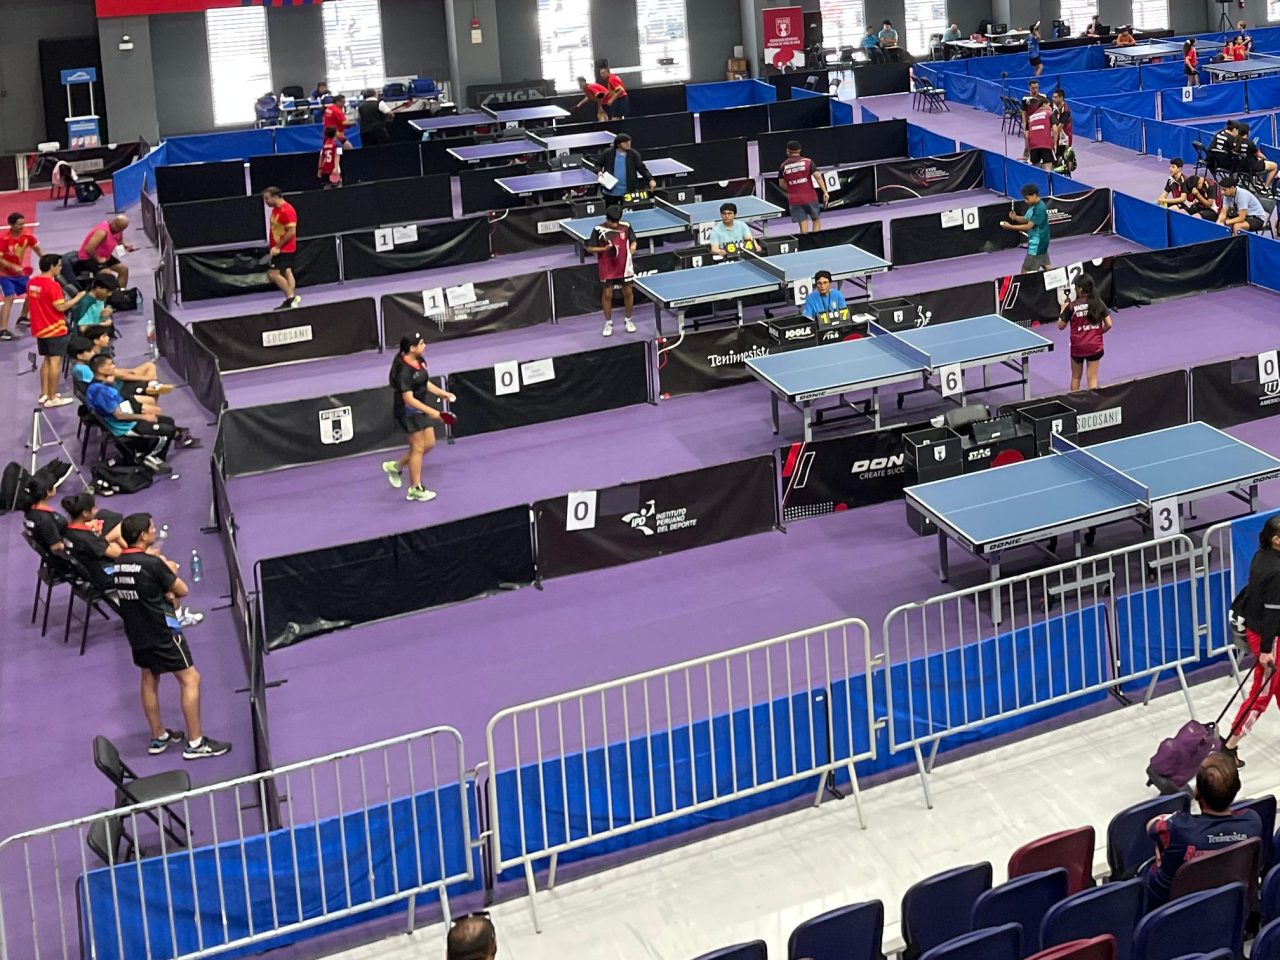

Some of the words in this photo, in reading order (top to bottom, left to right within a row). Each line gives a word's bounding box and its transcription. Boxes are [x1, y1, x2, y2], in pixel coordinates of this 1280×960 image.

[829, 176, 836, 187] 0
[967, 213, 975, 224] 0
[380, 234, 388, 246] 1
[798, 285, 809, 300] 9
[429, 295, 440, 309] 1
[840, 308, 849, 320] 7
[266, 327, 310, 344] SOCOSANI
[785, 326, 812, 339] JOOLA
[1021, 348, 1046, 356] DONIC
[1264, 359, 1274, 376] 0
[501, 371, 513, 386] 0
[946, 372, 958, 390] 6
[799, 391, 827, 400] DONIC
[1077, 413, 1120, 429] SOCOSANI
[968, 447, 992, 461] STAG
[851, 453, 904, 473] DON
[859, 468, 886, 480] CREATE
[887, 465, 905, 477] SUCC
[1252, 473, 1280, 484] DONIC
[574, 501, 589, 521] 0
[656, 507, 687, 520] INSTITUTO
[631, 515, 647, 527] IPD
[656, 515, 685, 526] PERUANO
[657, 524, 669, 533] DEL
[669, 519, 697, 532] DEPORTE
[1159, 507, 1173, 532] 3
[989, 537, 1022, 551] DONIC
